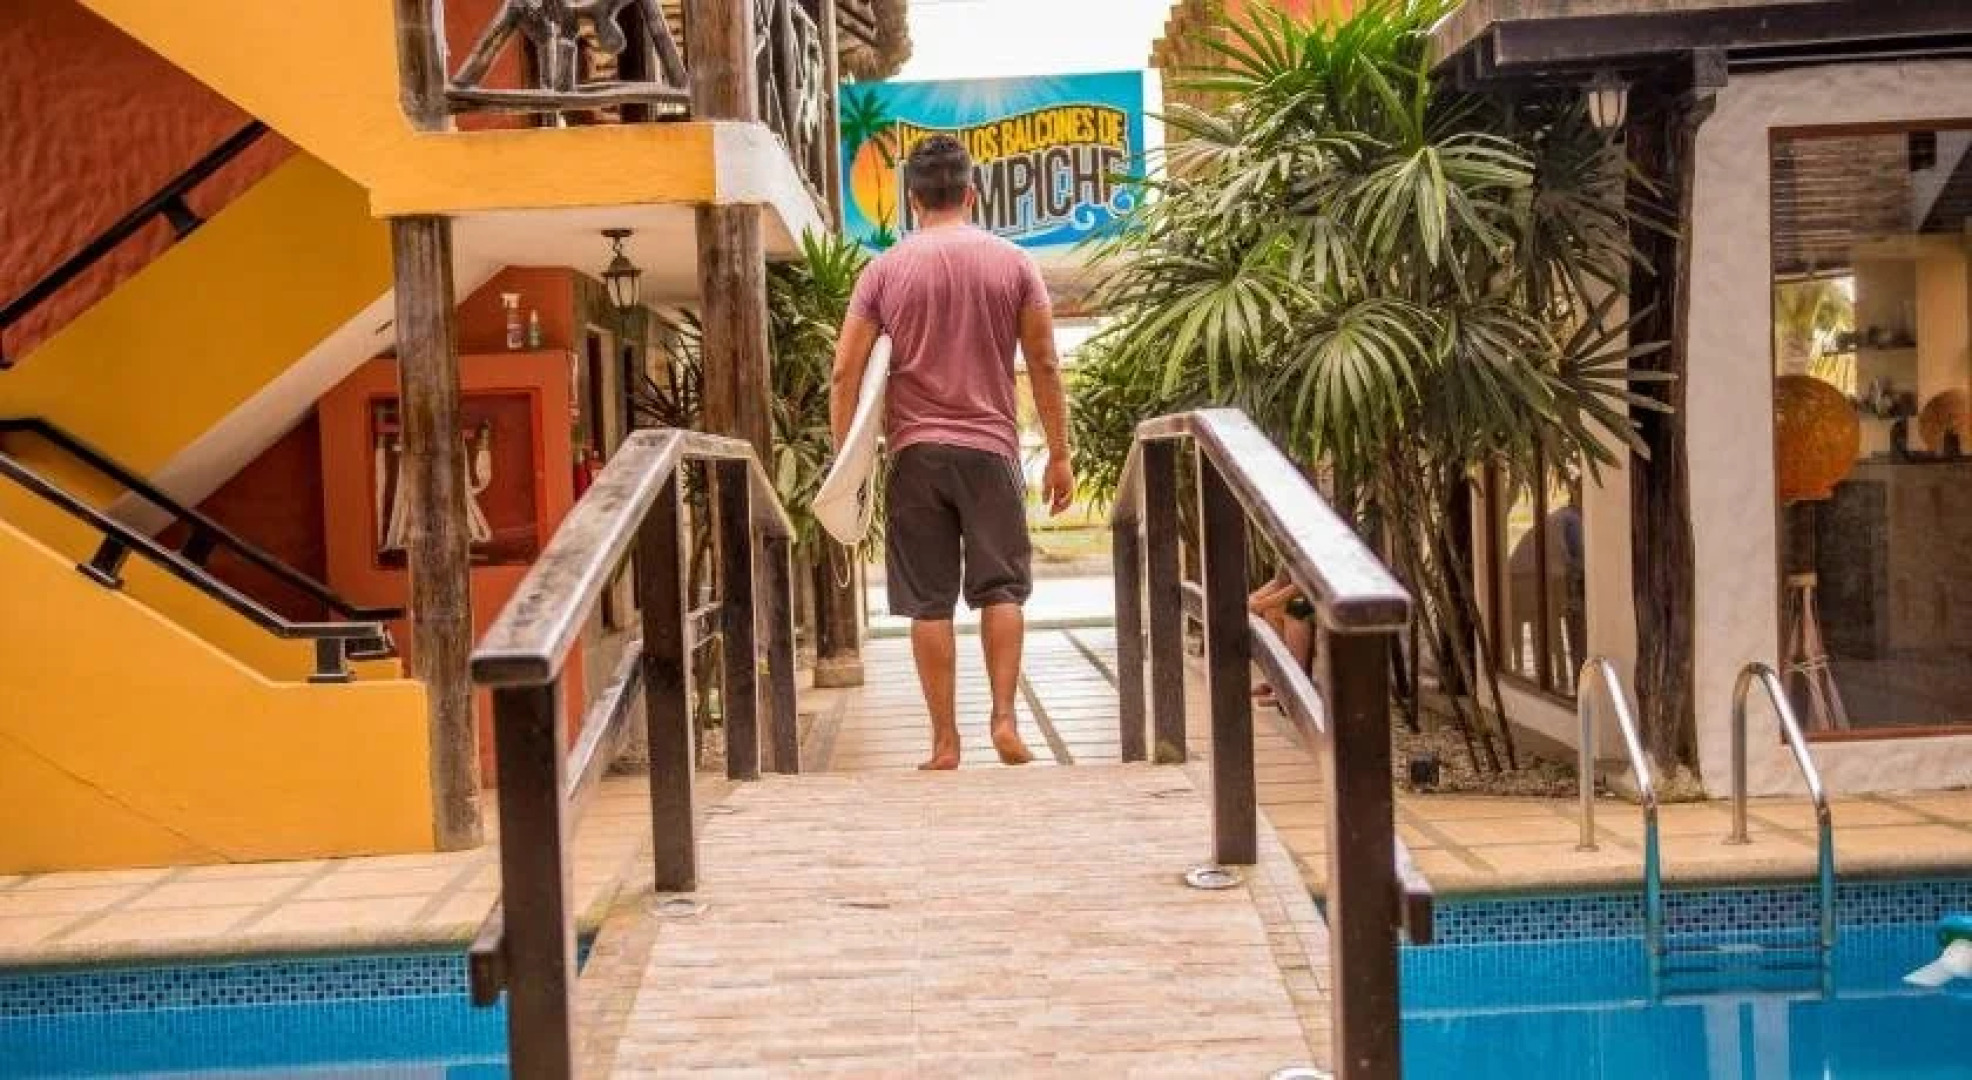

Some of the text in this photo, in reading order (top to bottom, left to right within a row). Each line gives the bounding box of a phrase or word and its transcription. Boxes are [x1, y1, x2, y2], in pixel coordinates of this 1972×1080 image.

[964, 124, 999, 164] LOS
[1002, 107, 1095, 156] BALCONES
[1099, 108, 1123, 148] DE
[902, 147, 1124, 231] MPICHE
